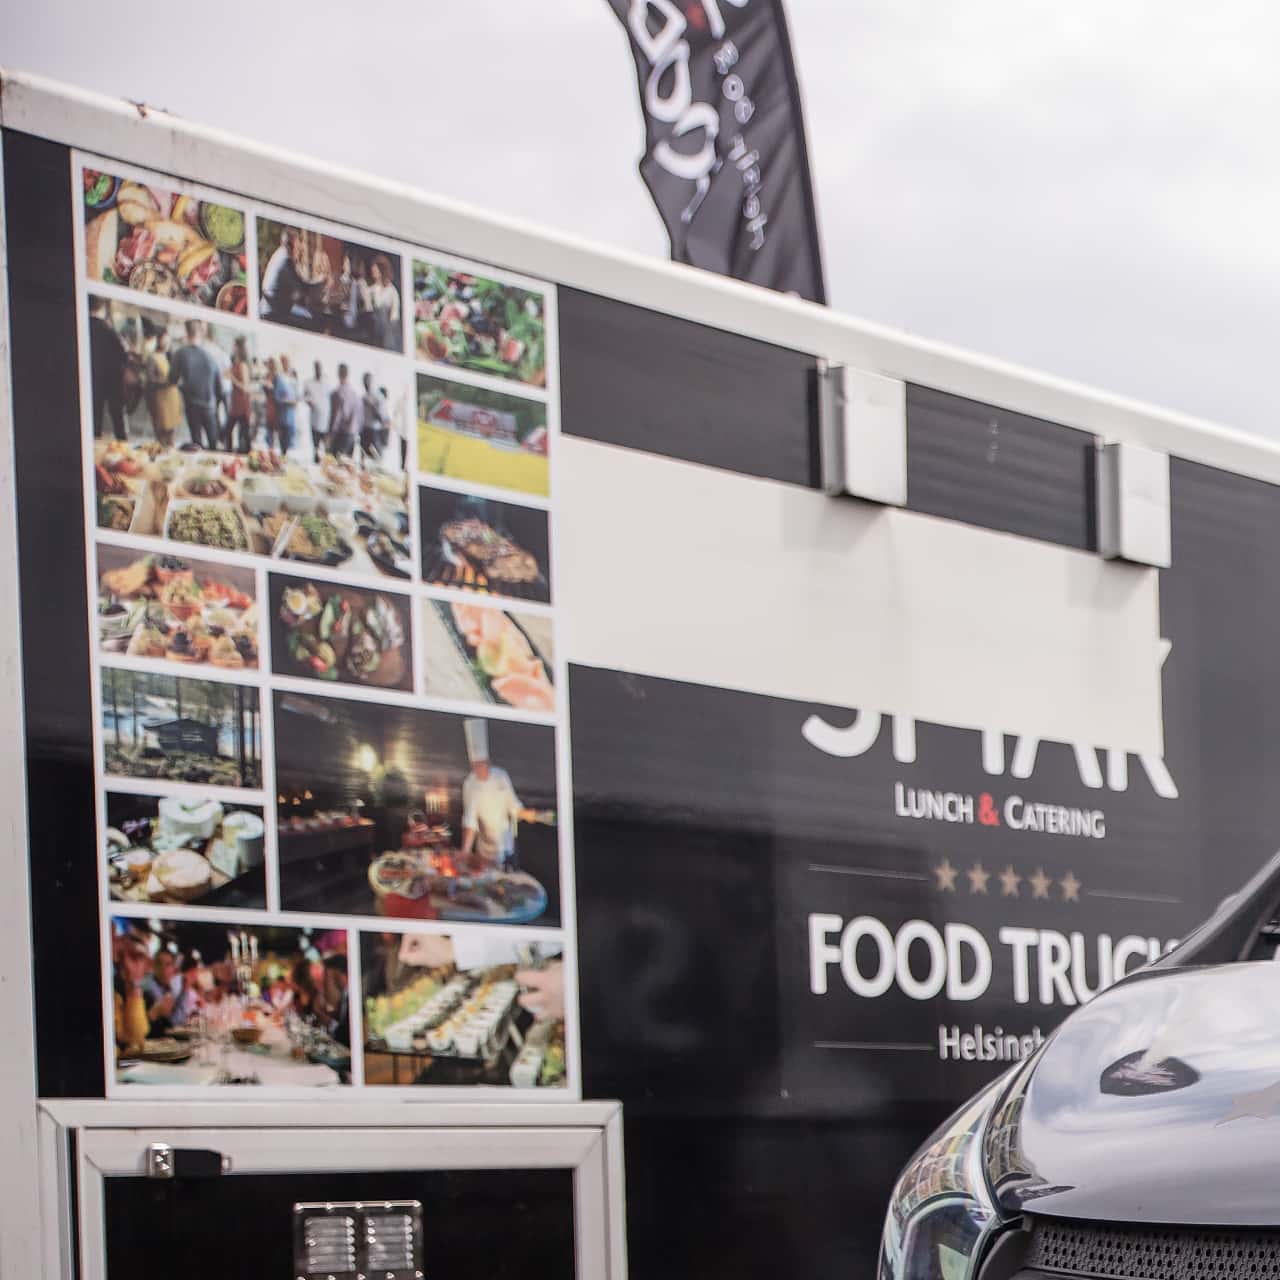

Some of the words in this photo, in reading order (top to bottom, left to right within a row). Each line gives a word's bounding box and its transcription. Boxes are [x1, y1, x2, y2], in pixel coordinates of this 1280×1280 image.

[894, 782, 974, 824] LUNCH
[978, 792, 999, 826] &
[1004, 795, 1106, 839] CATERING
[807, 912, 993, 1002] FOOD
